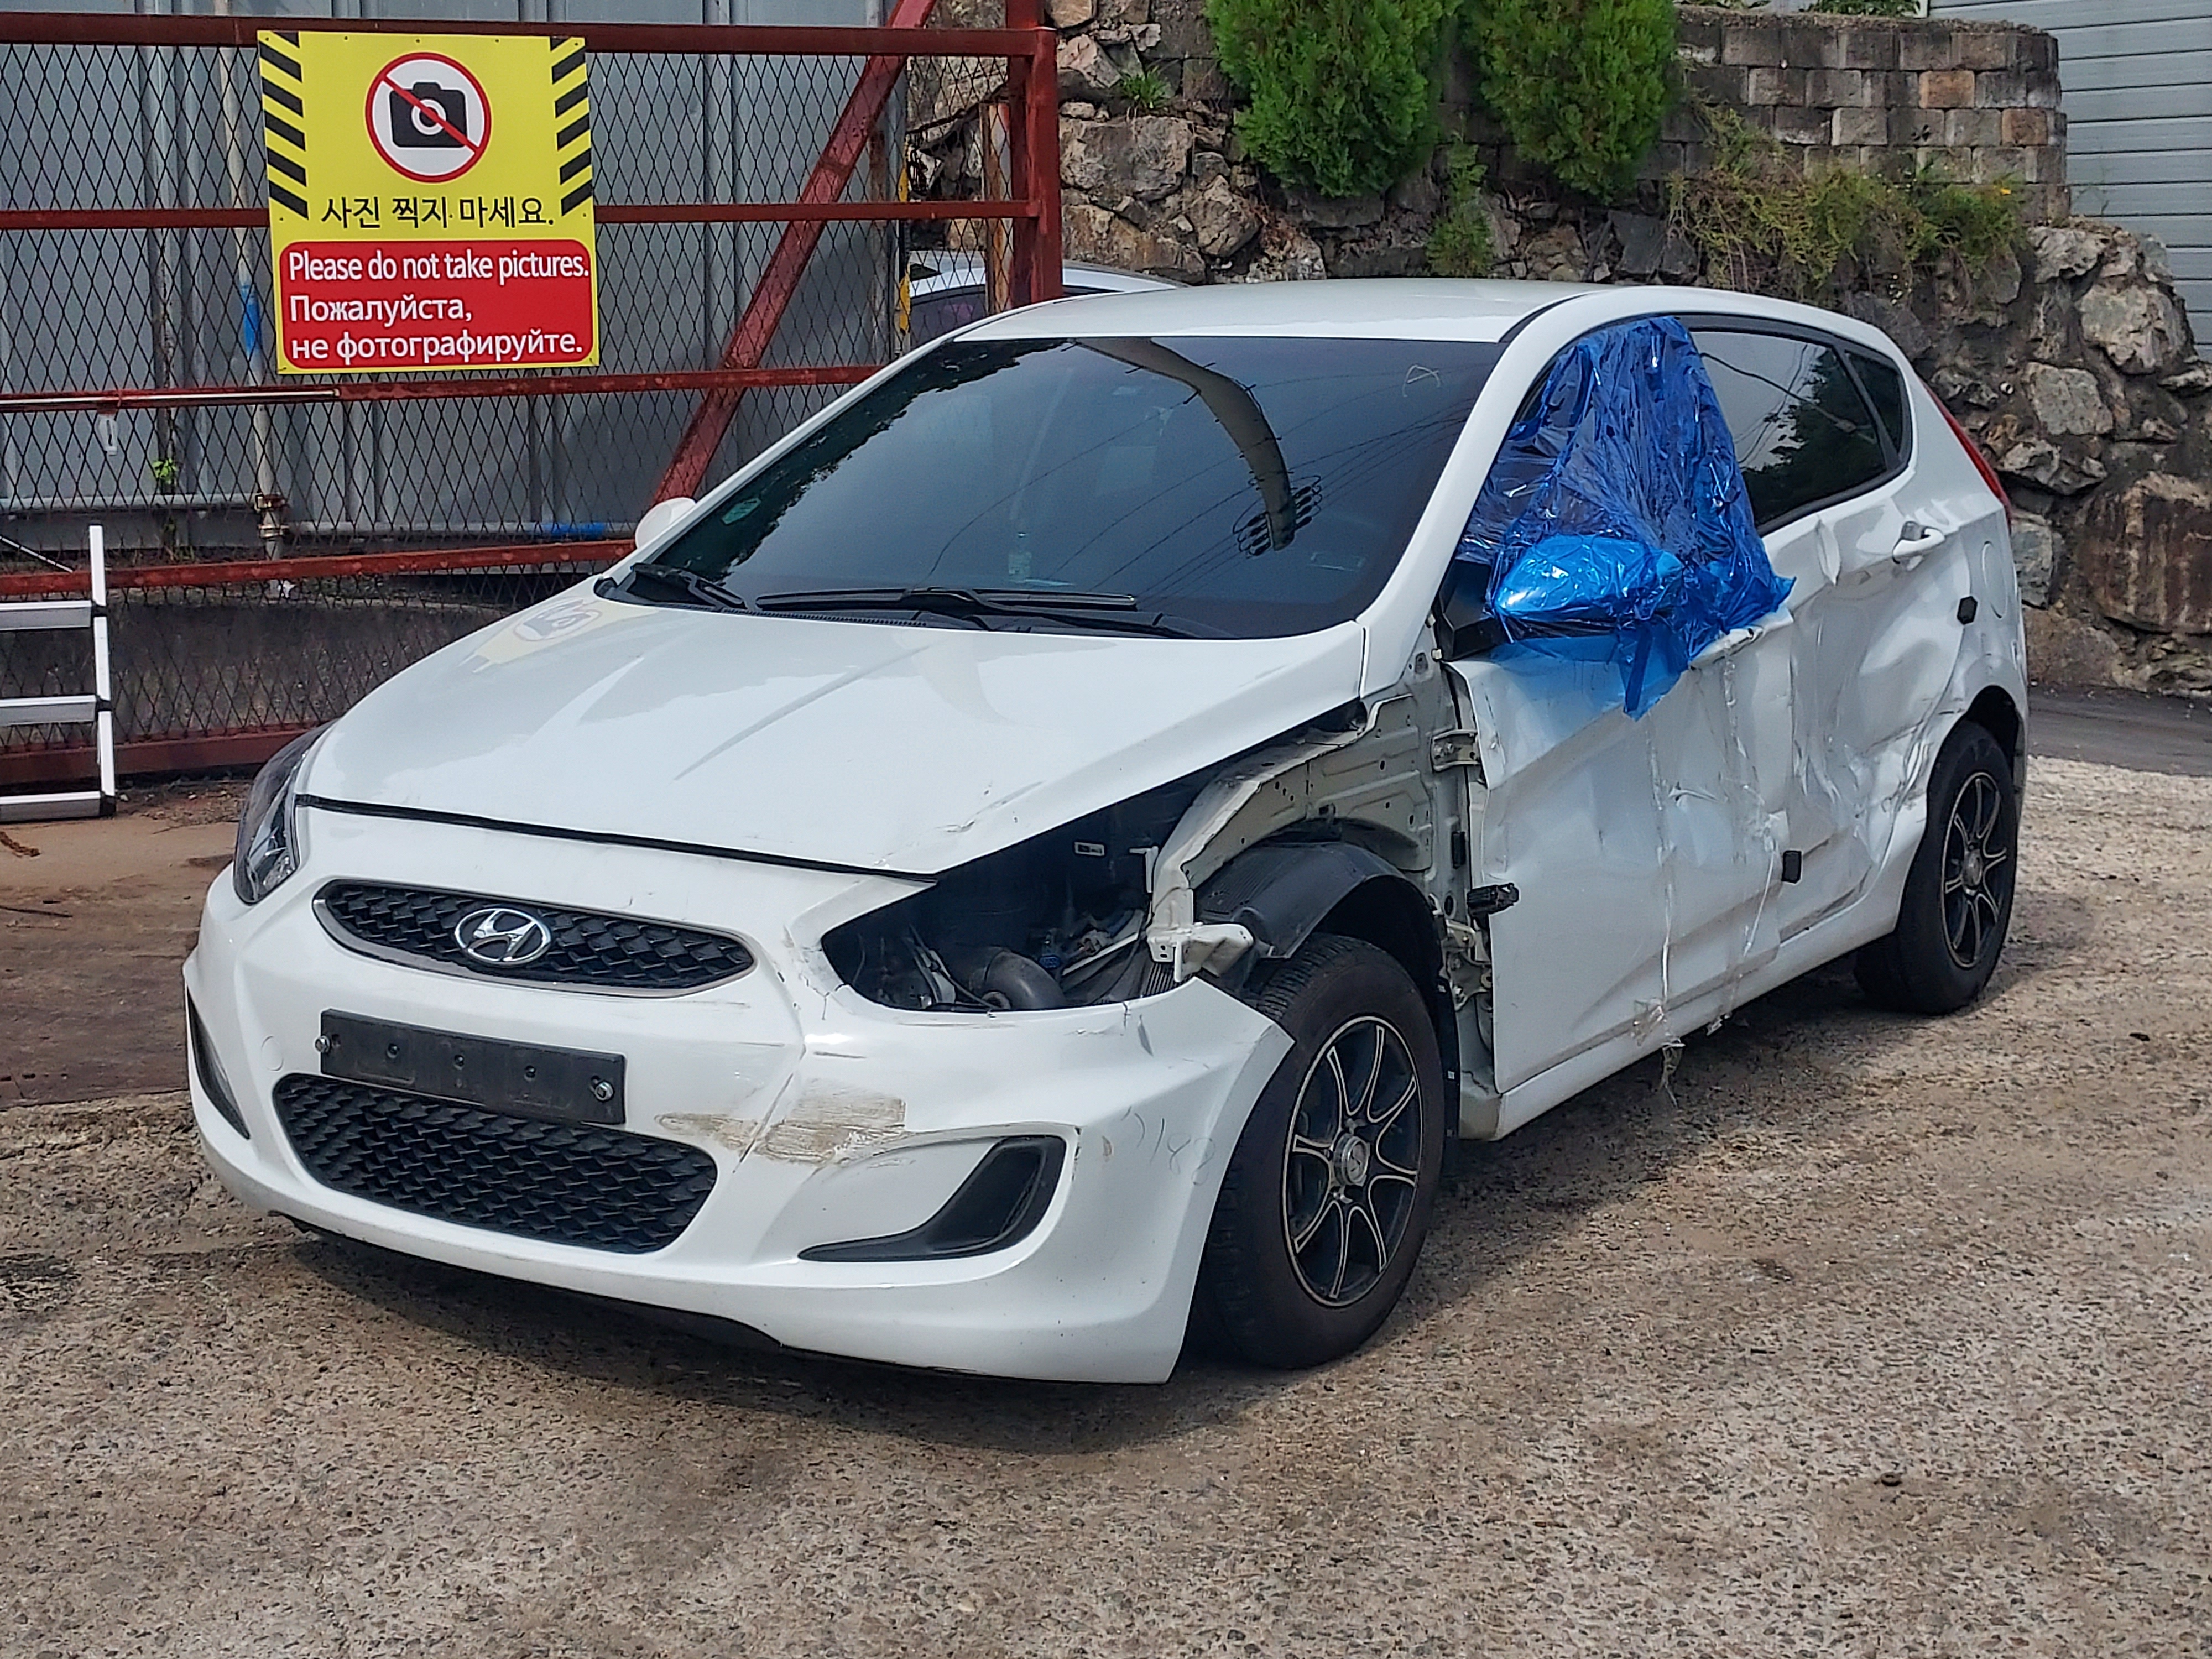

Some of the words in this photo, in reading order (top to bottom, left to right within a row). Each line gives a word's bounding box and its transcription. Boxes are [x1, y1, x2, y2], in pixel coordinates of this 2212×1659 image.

[321, 196, 381, 229] 사진
[390, 196, 448, 228] 찍지
[459, 196, 554, 228] 마세요.
[289, 249, 363, 281] Please
[368, 249, 397, 280] do
[403, 253, 441, 280] not
[444, 248, 494, 279] take
[498, 249, 589, 286] pictures.
[290, 294, 472, 328] Пожалуйста,
[292, 338, 329, 359] не
[336, 328, 583, 367] фотографируйте.
